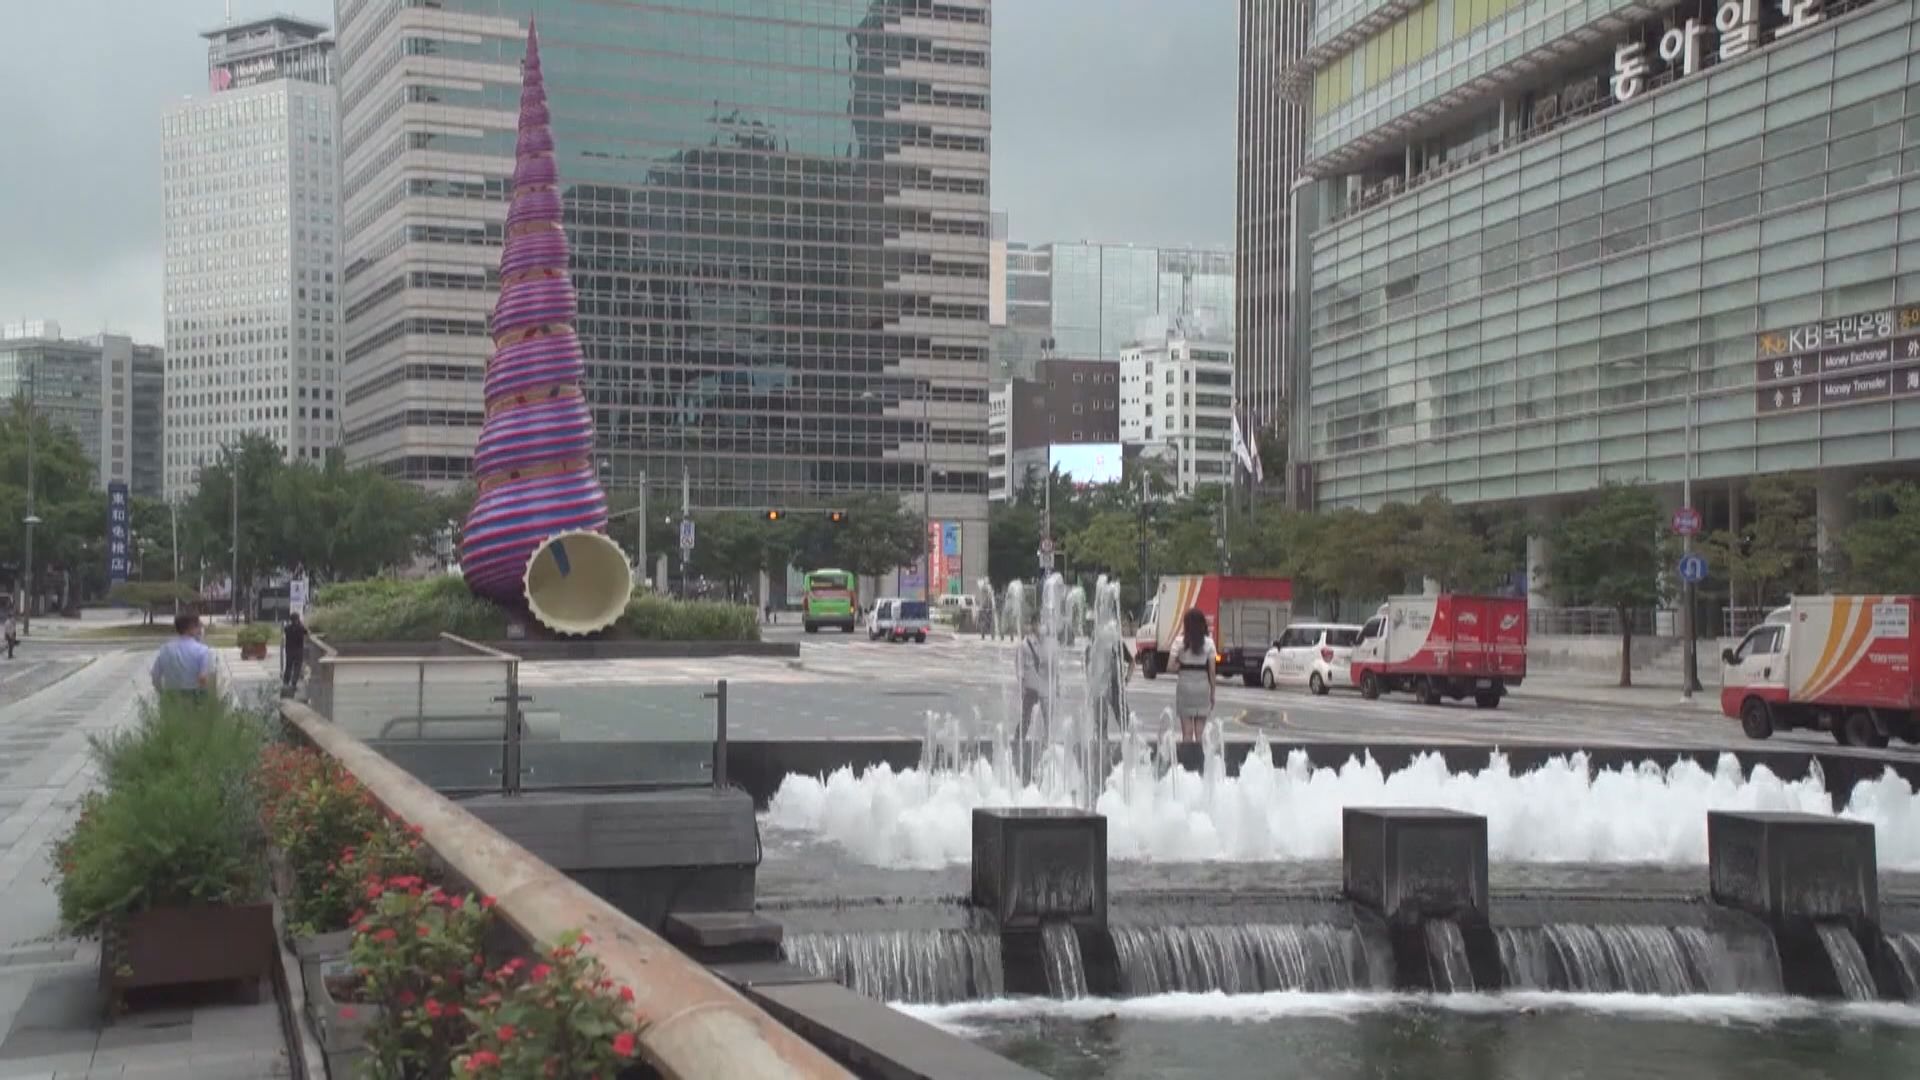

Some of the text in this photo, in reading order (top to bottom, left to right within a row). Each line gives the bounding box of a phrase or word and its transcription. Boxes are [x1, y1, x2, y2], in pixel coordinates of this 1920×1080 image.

[1825, 349, 1888, 366] Money Exchange
[1825, 377, 1886, 395] Money Transfer
